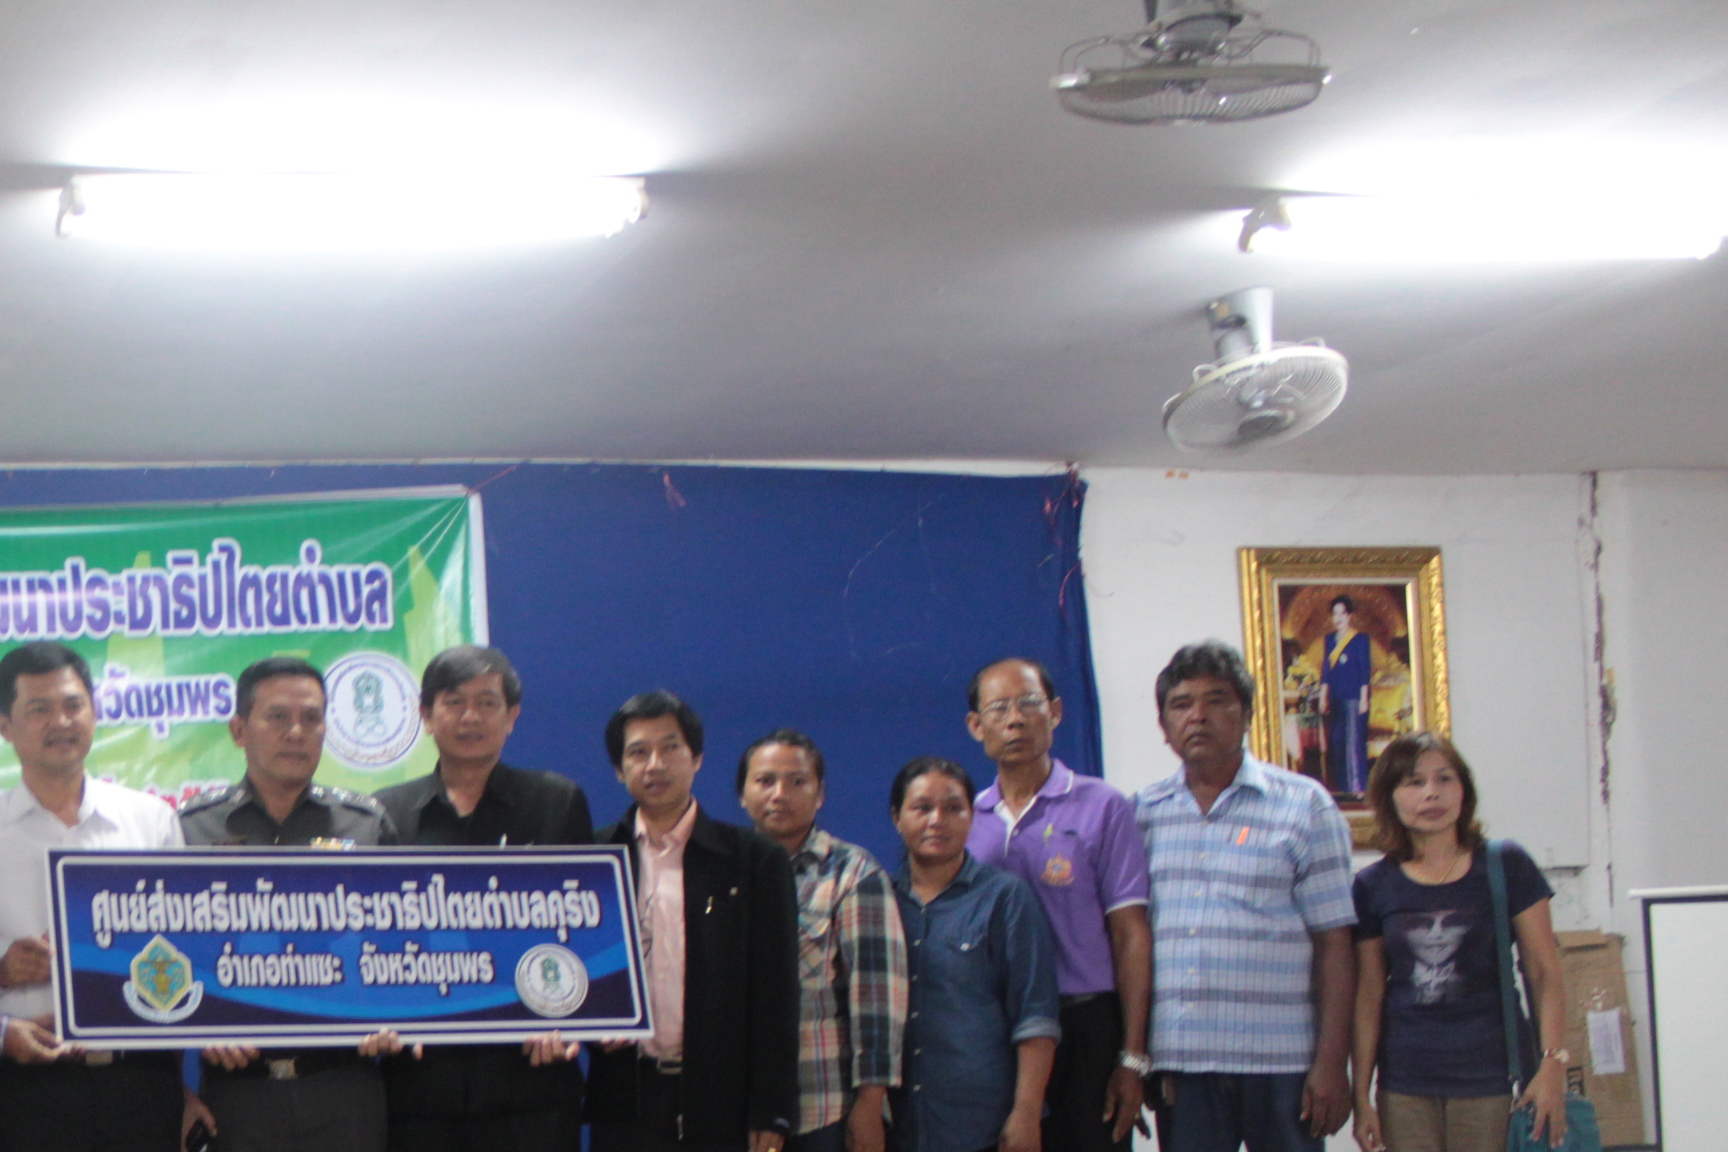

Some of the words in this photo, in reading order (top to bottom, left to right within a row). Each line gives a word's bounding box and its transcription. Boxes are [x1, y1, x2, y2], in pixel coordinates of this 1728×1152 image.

[91, 873, 601, 949] ศูนย์ส่งเสริมพัฒนาประชาธิปไตยตำบลคุริง
[216, 940, 343, 987] อำเภอท่าแซะ
[359, 940, 495, 996] จังหวัดชุมพร
